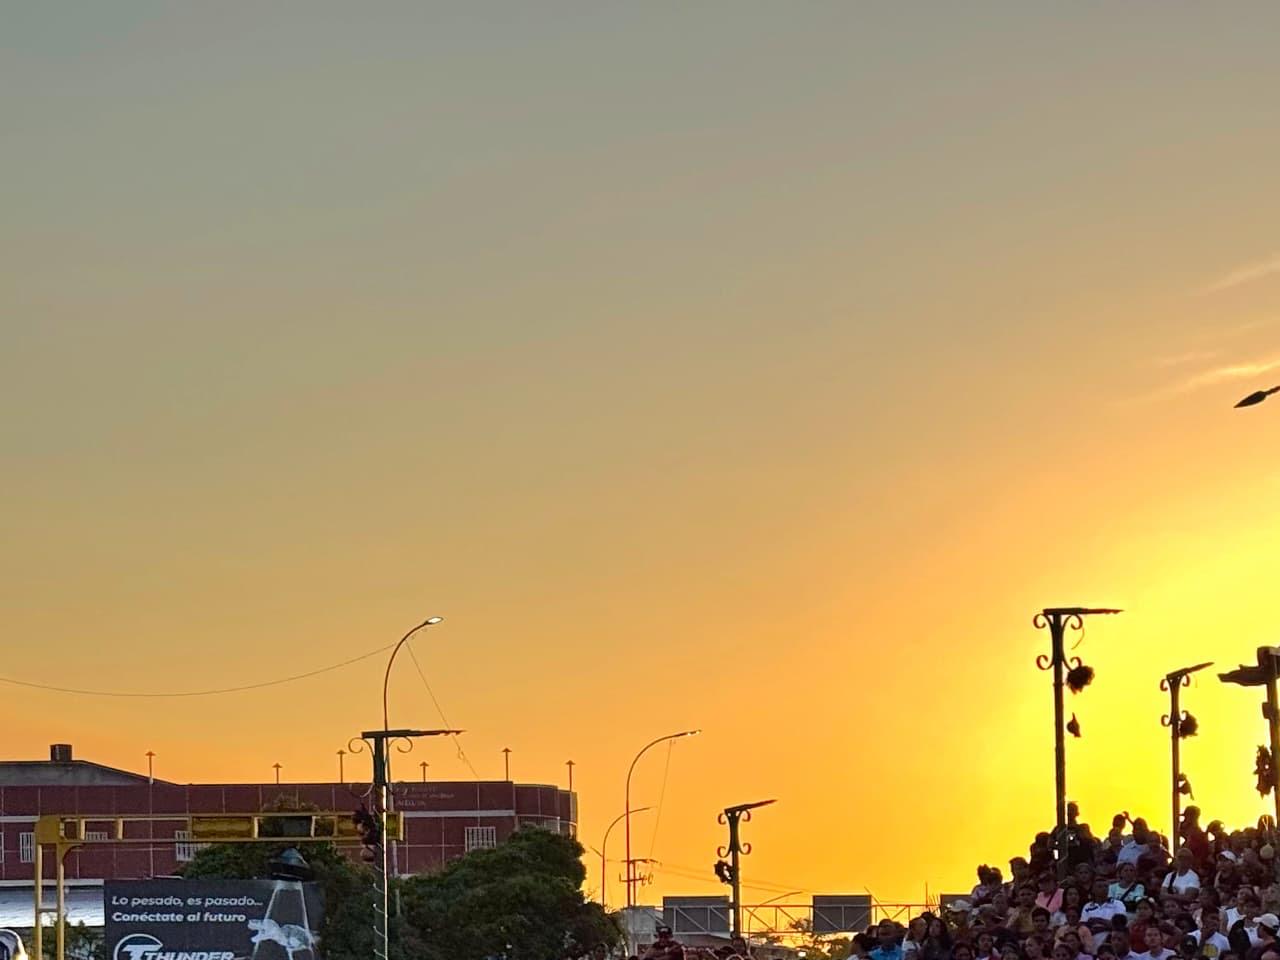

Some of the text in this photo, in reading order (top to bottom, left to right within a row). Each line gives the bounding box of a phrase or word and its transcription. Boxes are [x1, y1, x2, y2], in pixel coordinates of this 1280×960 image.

[112, 896, 263, 907] Lo pesado, es pasado...
[112, 911, 246, 922] Conéctate al futuro
